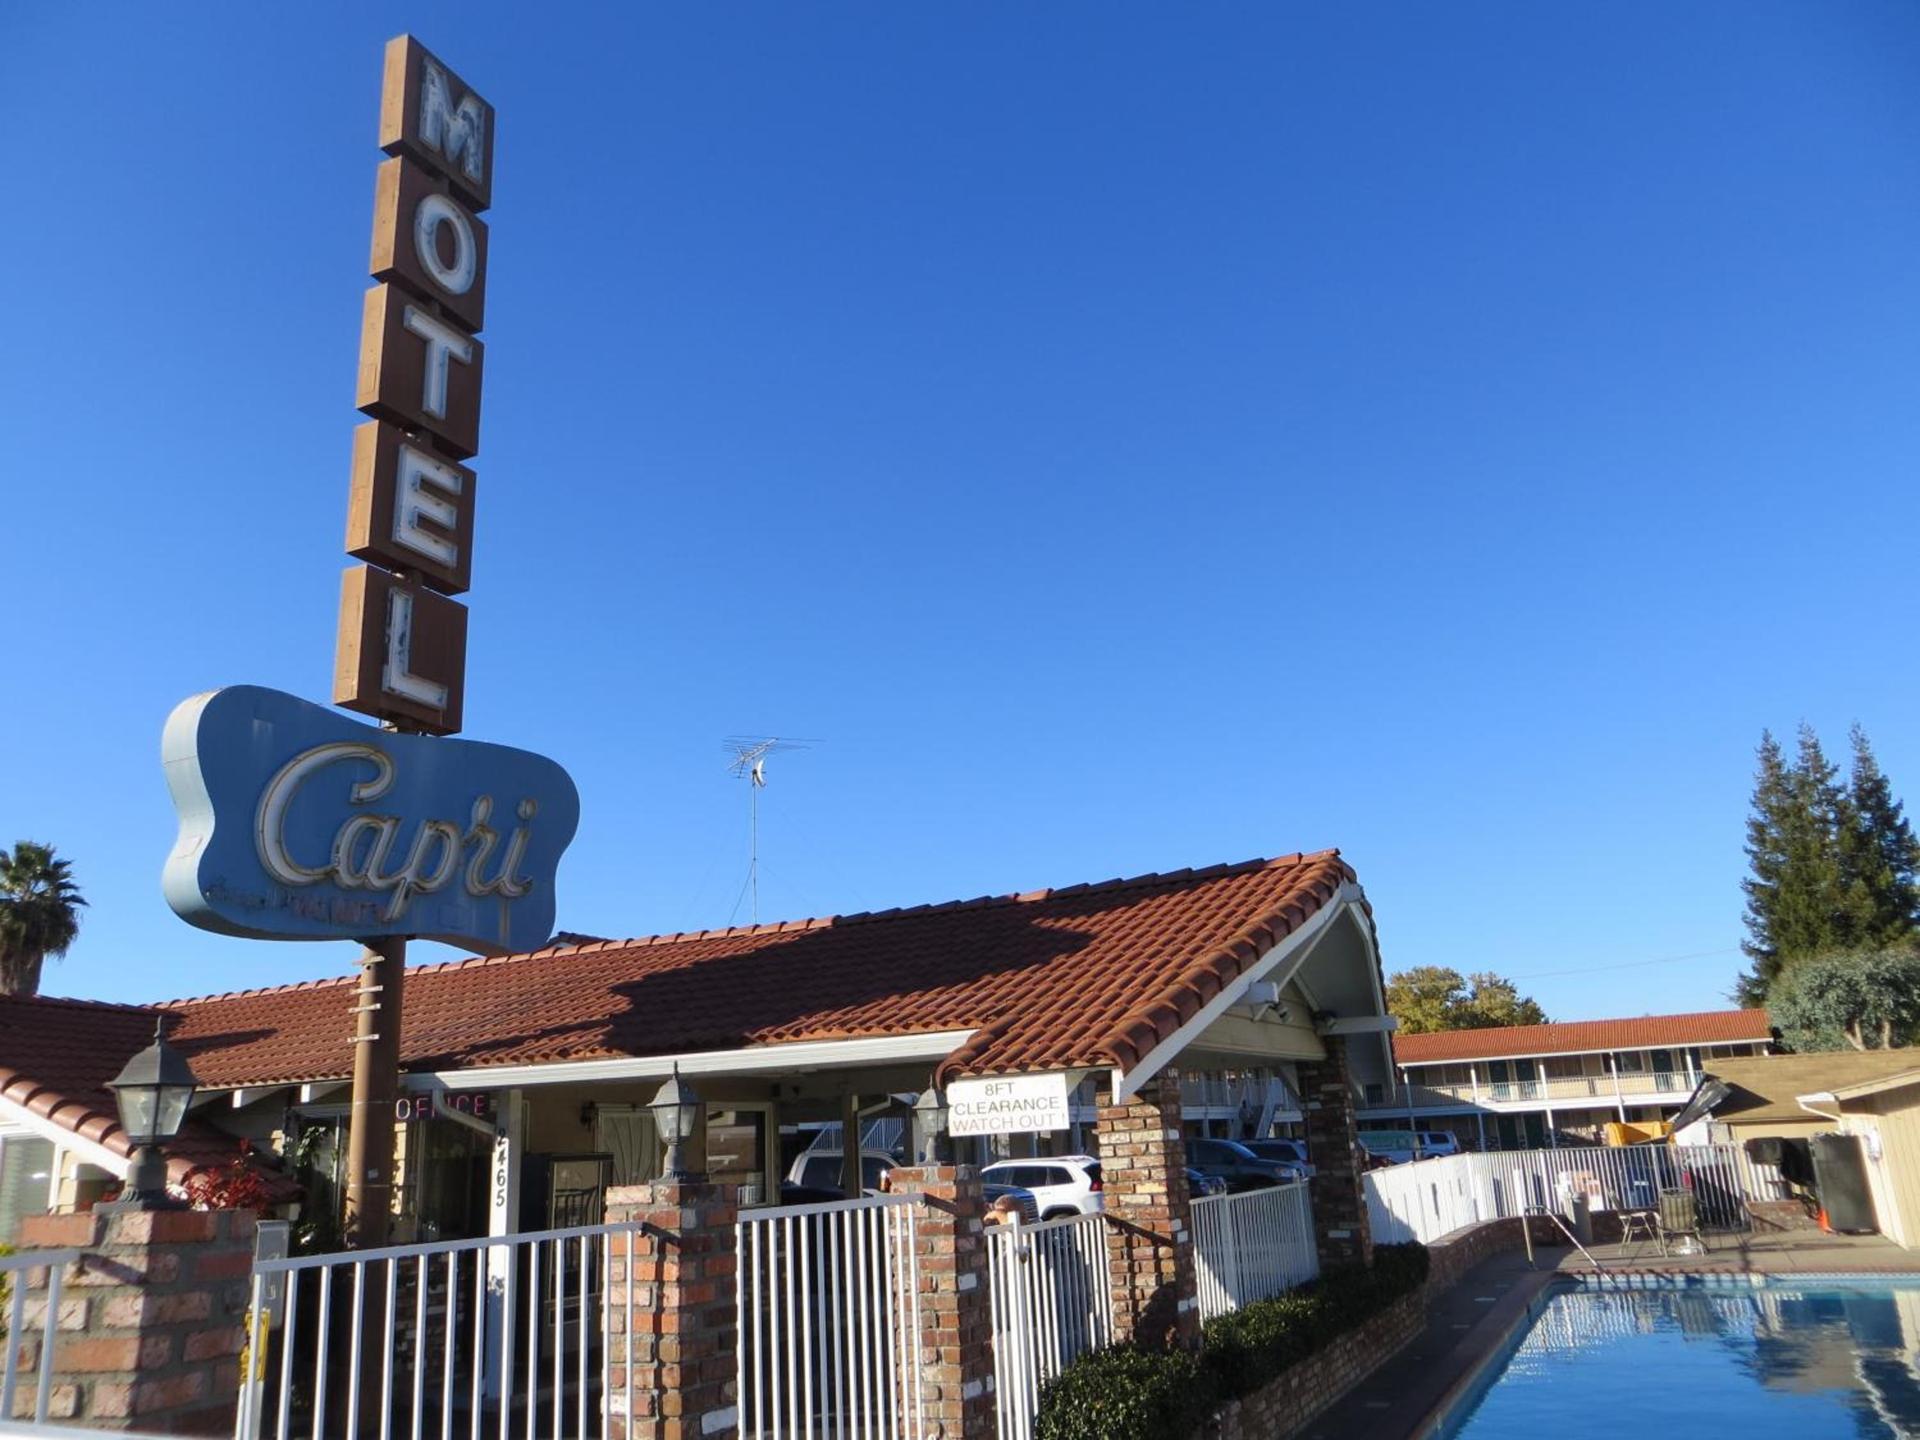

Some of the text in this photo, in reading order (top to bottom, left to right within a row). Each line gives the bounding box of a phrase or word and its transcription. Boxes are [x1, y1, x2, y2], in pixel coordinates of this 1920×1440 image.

[382, 54, 486, 710] MOTEL
[255, 741, 539, 921] Capri
[954, 1096, 1060, 1116] CLEARANCE
[985, 1082, 1014, 1096] 8FT
[953, 1117, 1013, 1132] WATCH
[496, 1128, 507, 1207] 2465
